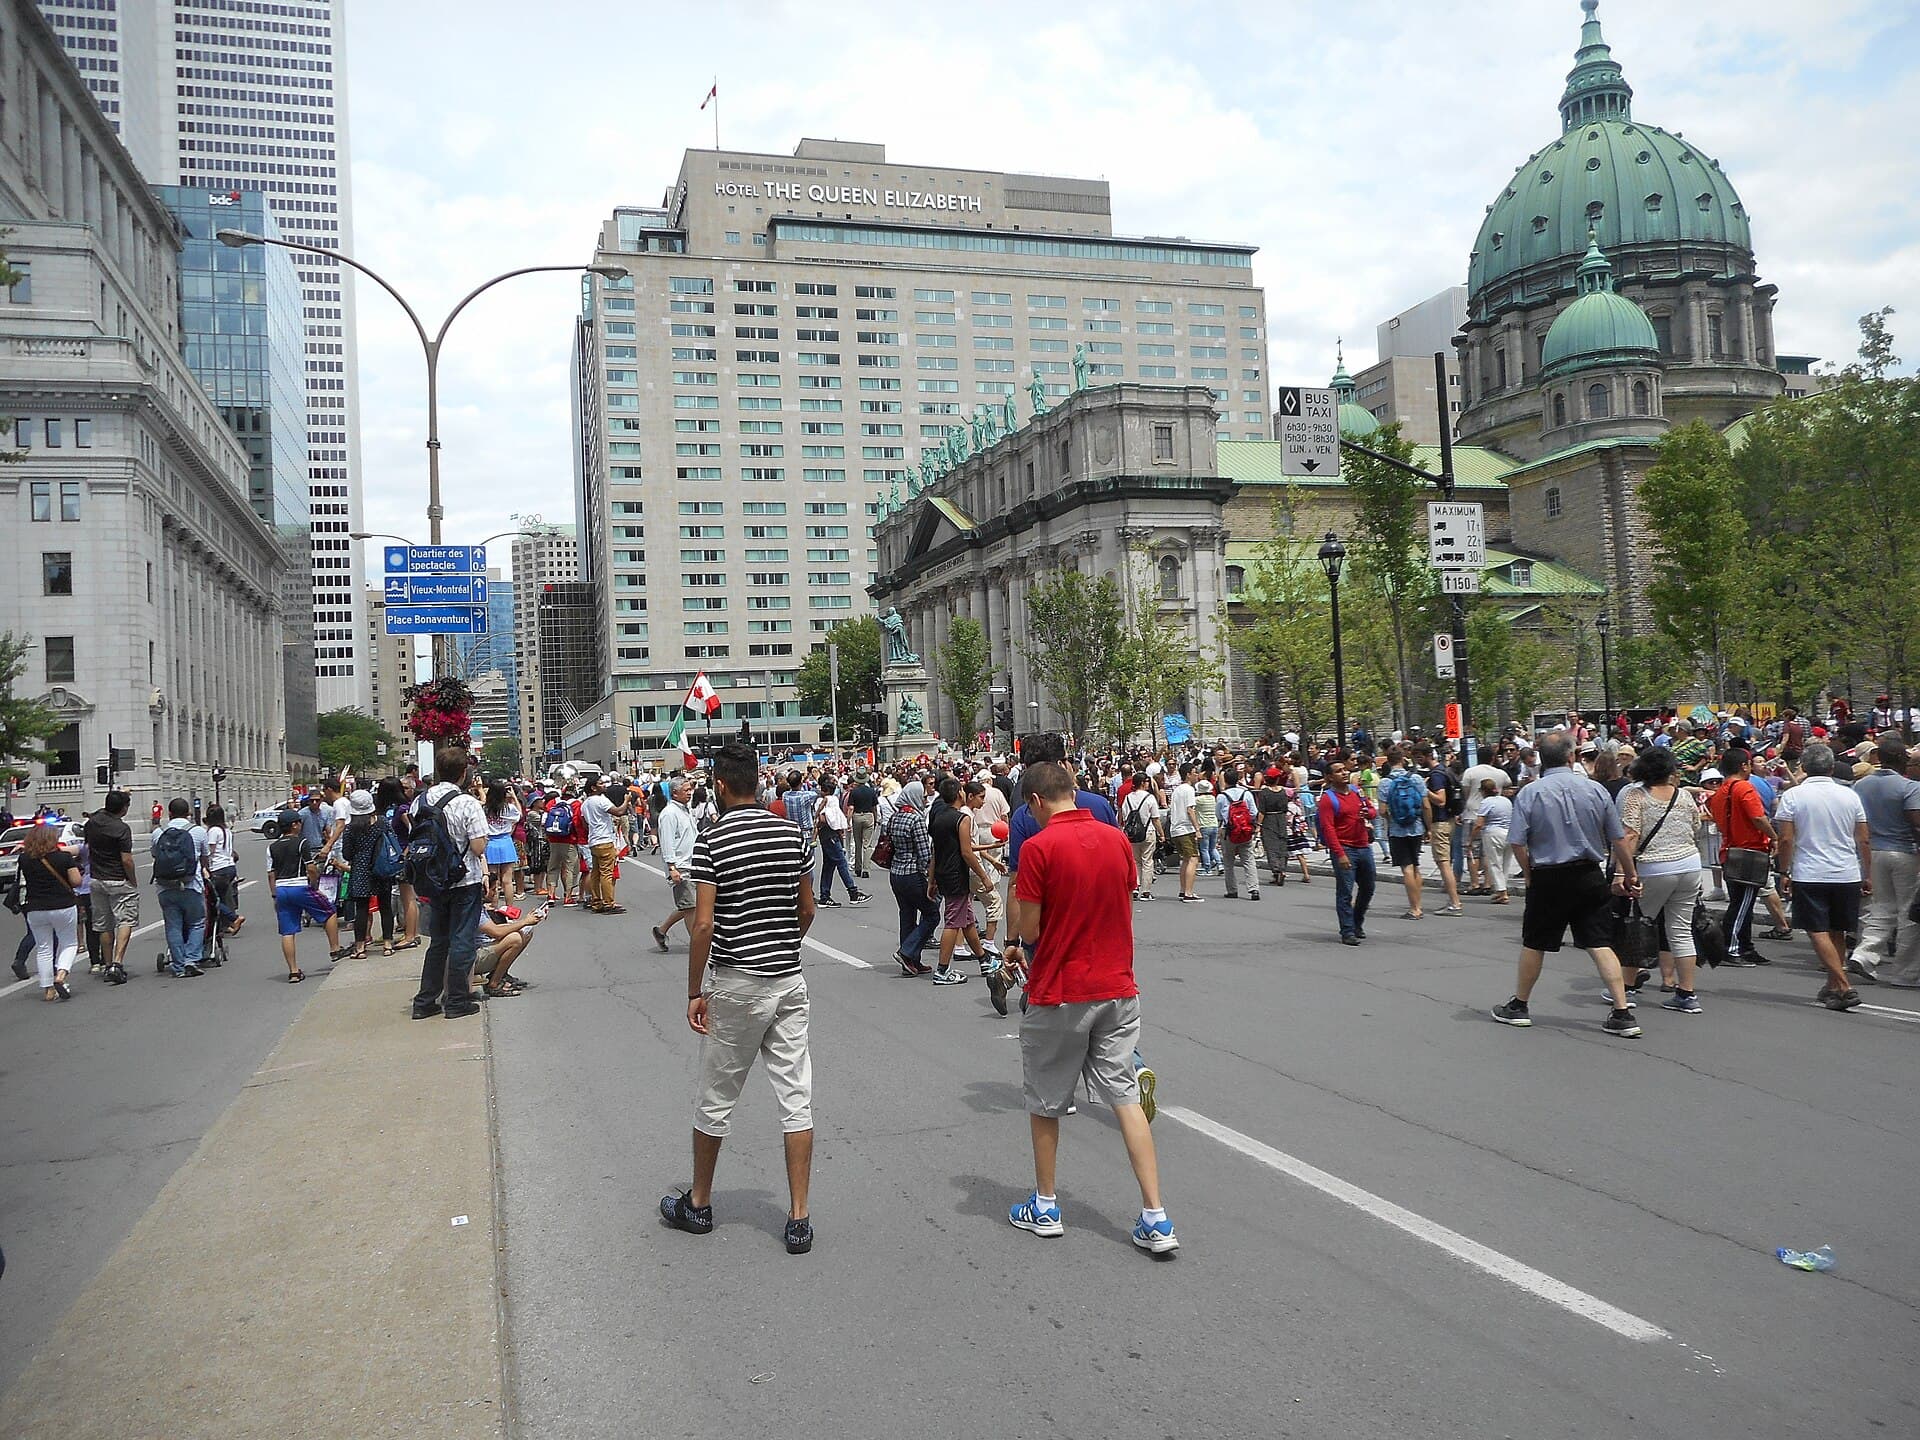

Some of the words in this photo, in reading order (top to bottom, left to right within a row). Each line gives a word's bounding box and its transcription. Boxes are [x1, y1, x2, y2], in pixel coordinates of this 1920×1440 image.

[208, 194, 233, 206] bdc
[714, 182, 760, 198] HÔTEL
[763, 181, 801, 200] THE
[808, 184, 878, 205] QUEEN
[884, 190, 982, 212] ELIZABETH
[1305, 393, 1329, 404] BUS
[1306, 407, 1331, 418] TAXI
[1434, 506, 1476, 516] MAXIMUM
[410, 548, 446, 558] Quartier
[448, 548, 464, 558] des
[410, 561, 456, 572] spectacles
[472, 561, 486, 571] 0.5
[411, 584, 470, 595] Vieux-Montréal
[387, 615, 412, 625] Place
[414, 614, 470, 624] Bonaventure
